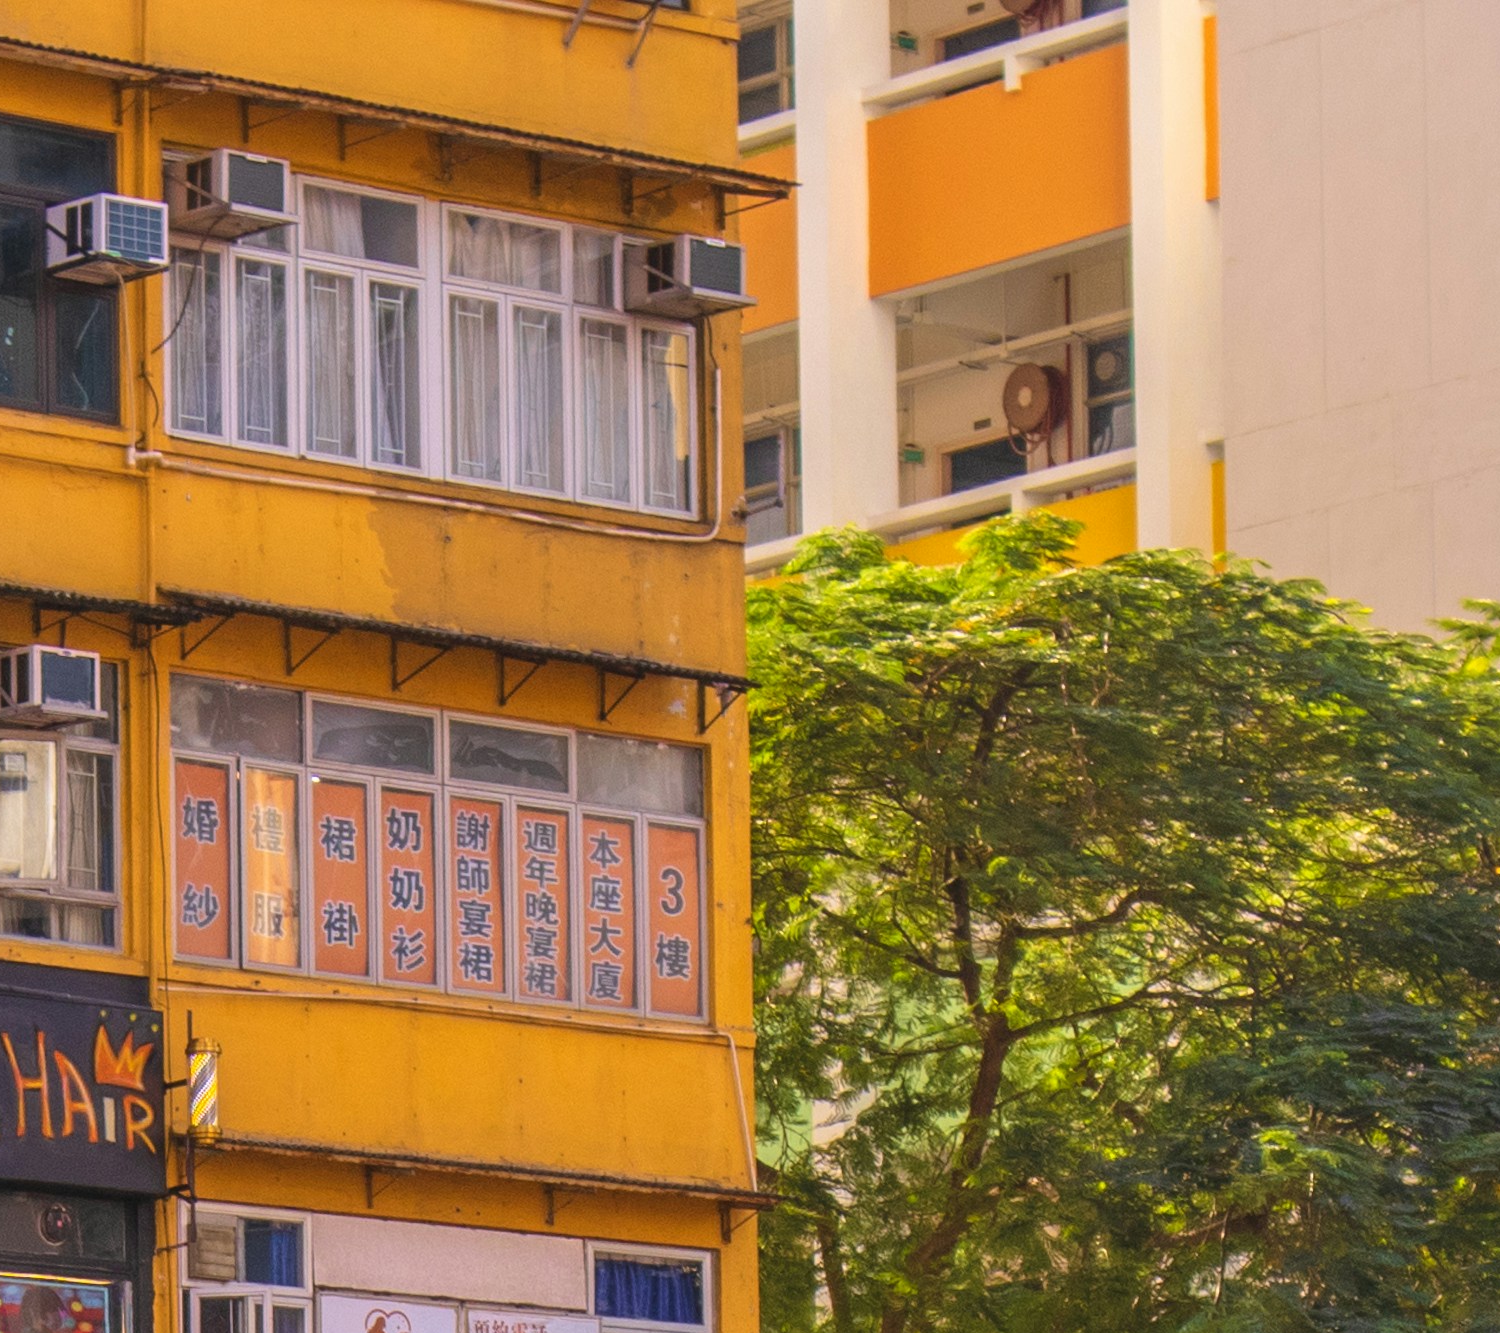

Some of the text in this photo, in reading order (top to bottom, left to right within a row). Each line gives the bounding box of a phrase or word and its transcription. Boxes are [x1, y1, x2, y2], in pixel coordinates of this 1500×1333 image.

[181, 795, 219, 928] 婚紗
[251, 805, 285, 940] 禮服
[321, 816, 358, 948] 裙褂
[387, 807, 426, 973] 奶奶衫
[455, 811, 495, 983] 謝師宴裙
[523, 819, 559, 998] 週年晚宴裙
[588, 832, 623, 1002] 本座大廈
[656, 866, 692, 981] 3樓
[3, 1024, 156, 1153] HAIR
